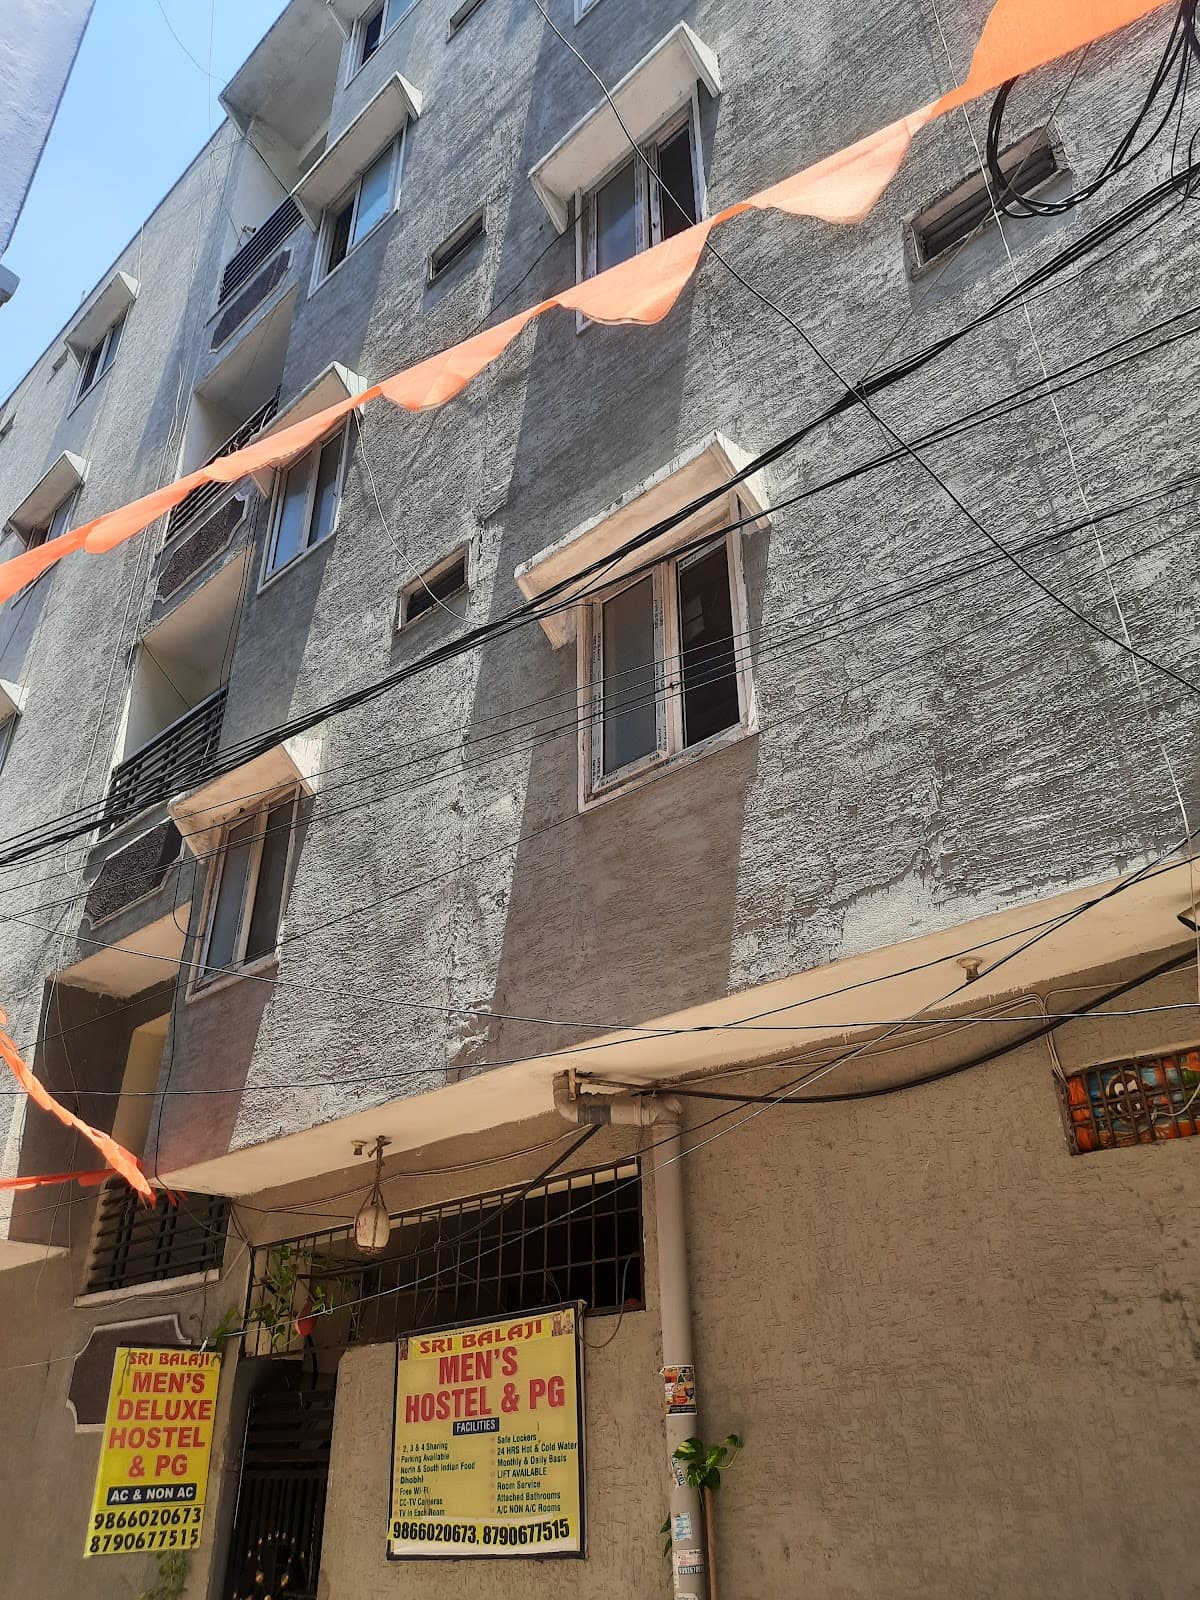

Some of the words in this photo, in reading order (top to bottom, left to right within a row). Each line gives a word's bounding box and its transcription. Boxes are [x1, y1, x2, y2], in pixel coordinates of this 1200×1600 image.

[419, 1338, 453, 1354] SRI
[462, 1319, 543, 1348] BALAJI
[129, 1351, 154, 1366] SRI
[159, 1352, 210, 1368] BALAJI
[439, 1346, 518, 1385] MEN'S
[132, 1371, 206, 1394] MEN'S
[405, 1386, 492, 1423] HOSTEL
[501, 1382, 520, 1413] &
[529, 1375, 565, 1409] PG
[117, 1399, 213, 1421] DELUXE
[456, 1418, 496, 1433] FACILITIES
[108, 1426, 206, 1449] HOSTEL
[512, 1433, 537, 1443] Lockers
[410, 1444, 414, 1452] 3
[421, 1443, 425, 1451] 4
[426, 1442, 448, 1451] Sharing
[497, 1447, 505, 1455] 24
[506, 1446, 520, 1455] HRS
[521, 1444, 533, 1454] Hot
[534, 1444, 540, 1453] &
[541, 1442, 556, 1452] Cold
[557, 1441, 577, 1450] Water
[128, 1455, 145, 1477] &
[155, 1454, 188, 1477] PG
[401, 1455, 422, 1464] Parking
[423, 1453, 449, 1461] Available
[497, 1457, 522, 1468] Monthly
[523, 1456, 529, 1465] &
[530, 1455, 547, 1465] Daily
[548, 1453, 567, 1463] Basis
[400, 1466, 416, 1475] North
[417, 1465, 422, 1473] &
[423, 1464, 440, 1473] South
[440, 1463, 460, 1471] Indian
[460, 1462, 475, 1470] Food
[497, 1469, 511, 1479] LIFT
[511, 1467, 547, 1478] AVAILABLE
[399, 1487, 413, 1496] Free
[497, 1481, 516, 1491] Room
[516, 1480, 541, 1489] Service
[110, 1489, 129, 1502] AC
[132, 1488, 142, 1500] &
[146, 1487, 174, 1500] NON
[177, 1486, 194, 1498] AC
[496, 1493, 525, 1502] Attached
[525, 1492, 561, 1500] Bathrooms
[399, 1499, 417, 1507] CC-TV
[496, 1505, 508, 1515] A/C
[509, 1504, 524, 1513] NON
[524, 1503, 537, 1513] A/C
[537, 1503, 561, 1512] Rooms
[94, 1507, 202, 1530] 9866020673
[399, 1509, 406, 1517] TV
[428, 1508, 445, 1516] Room
[393, 1521, 480, 1545] 9866020673,
[482, 1518, 570, 1545] 8790677515
[89, 1527, 199, 1553] 8790677515
